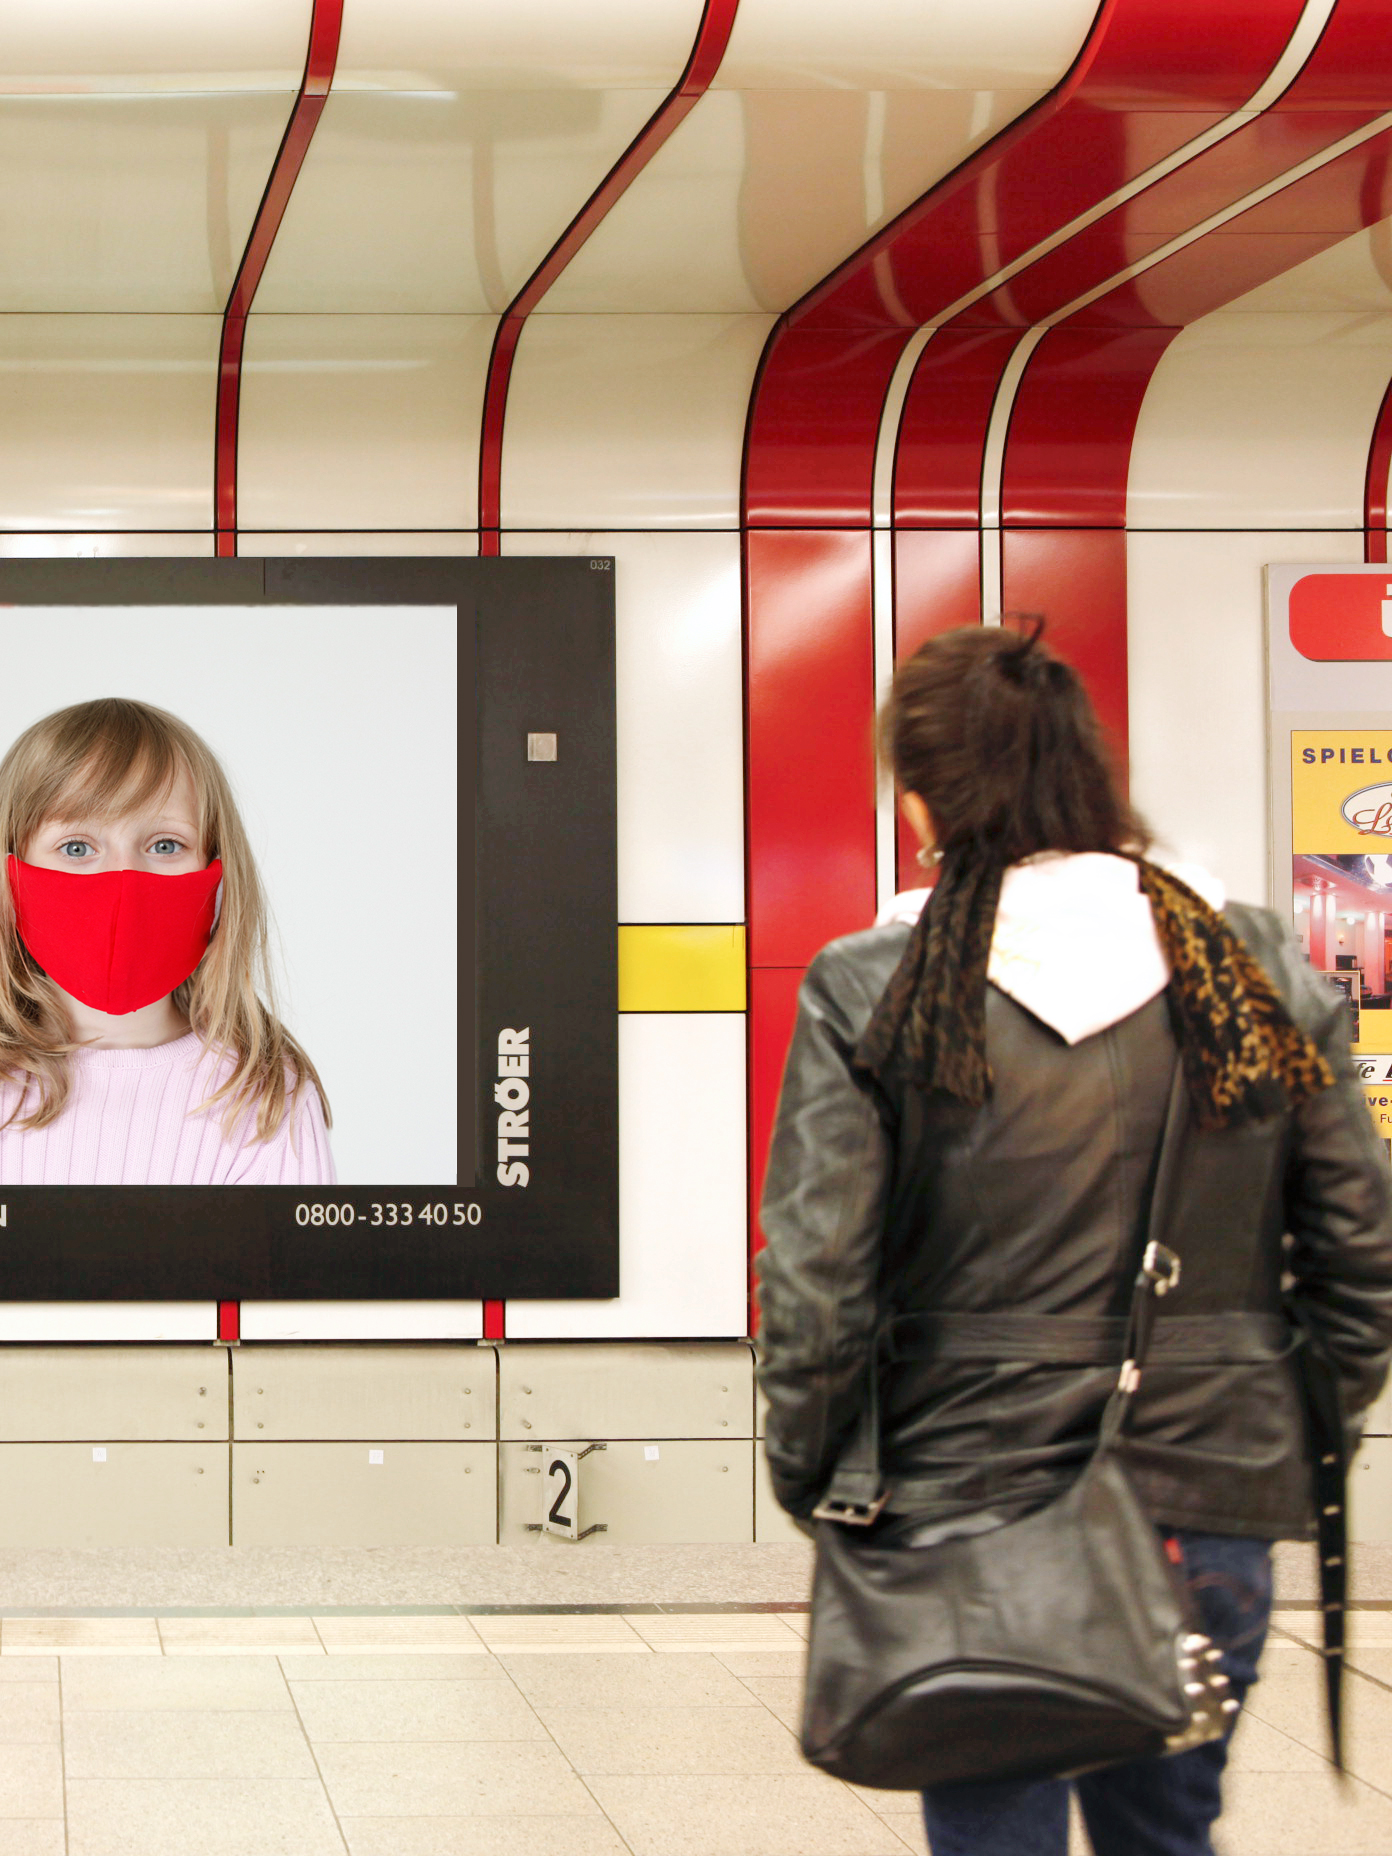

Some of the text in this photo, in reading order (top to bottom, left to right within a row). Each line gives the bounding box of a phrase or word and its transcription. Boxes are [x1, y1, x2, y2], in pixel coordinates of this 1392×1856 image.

[590, 559, 611, 571] 032
[494, 1026, 530, 1188] STRÖER
[548, 1459, 572, 1528] 2
